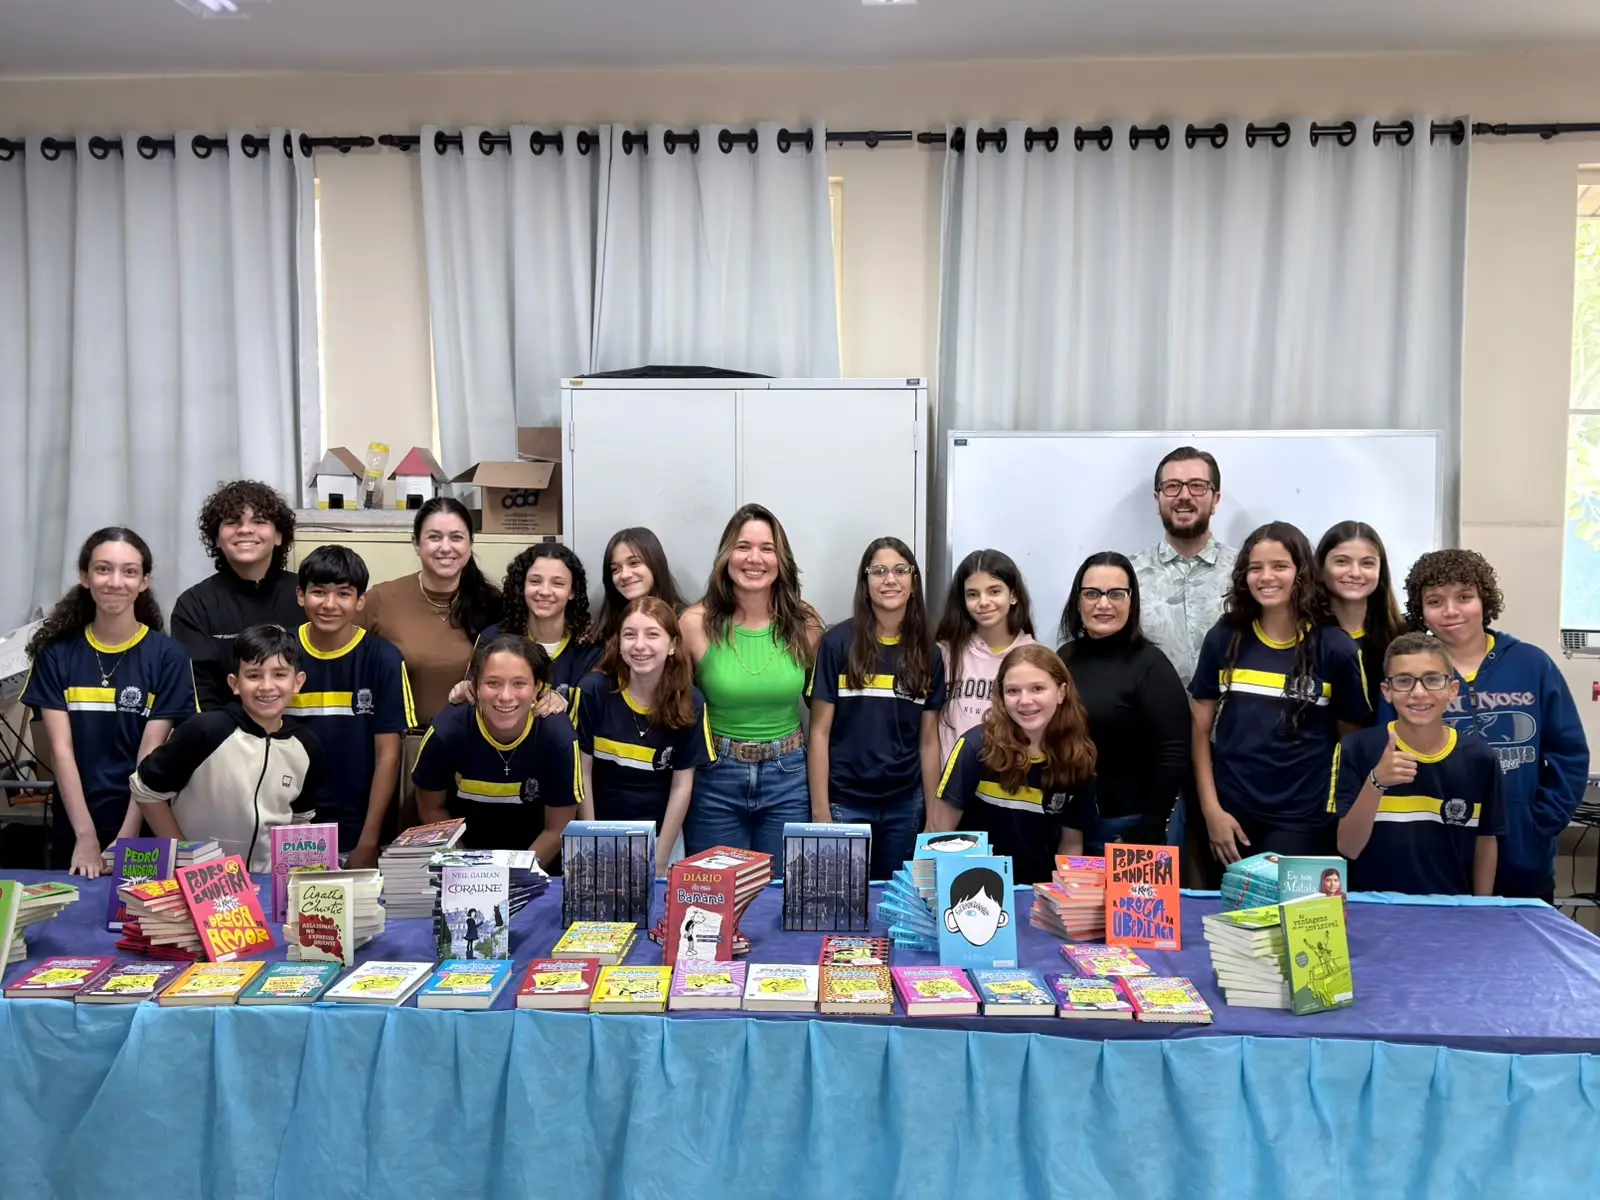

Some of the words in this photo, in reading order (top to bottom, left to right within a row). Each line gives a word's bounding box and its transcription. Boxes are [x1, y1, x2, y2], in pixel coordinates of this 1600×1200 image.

[964, 706, 981, 714] NEW
[125, 847, 159, 862] PEDRO
[122, 864, 158, 877] BANDEIRA
[683, 872, 722, 882] DIÁRIO
[1113, 857, 1173, 885] BANDEIRA
[1287, 870, 1298, 880] Eu
[194, 864, 249, 904] BANDEIRA
[448, 883, 502, 895] CORALINE
[1282, 880, 1318, 894] Malala
[303, 886, 344, 904] Agatha
[677, 888, 725, 905] Banana
[301, 900, 343, 914] Christie
[1119, 897, 1167, 922] DROGA
[208, 906, 257, 929] DROGA
[302, 923, 338, 931] ASSASSINATO
[207, 928, 269, 956] AMOR
